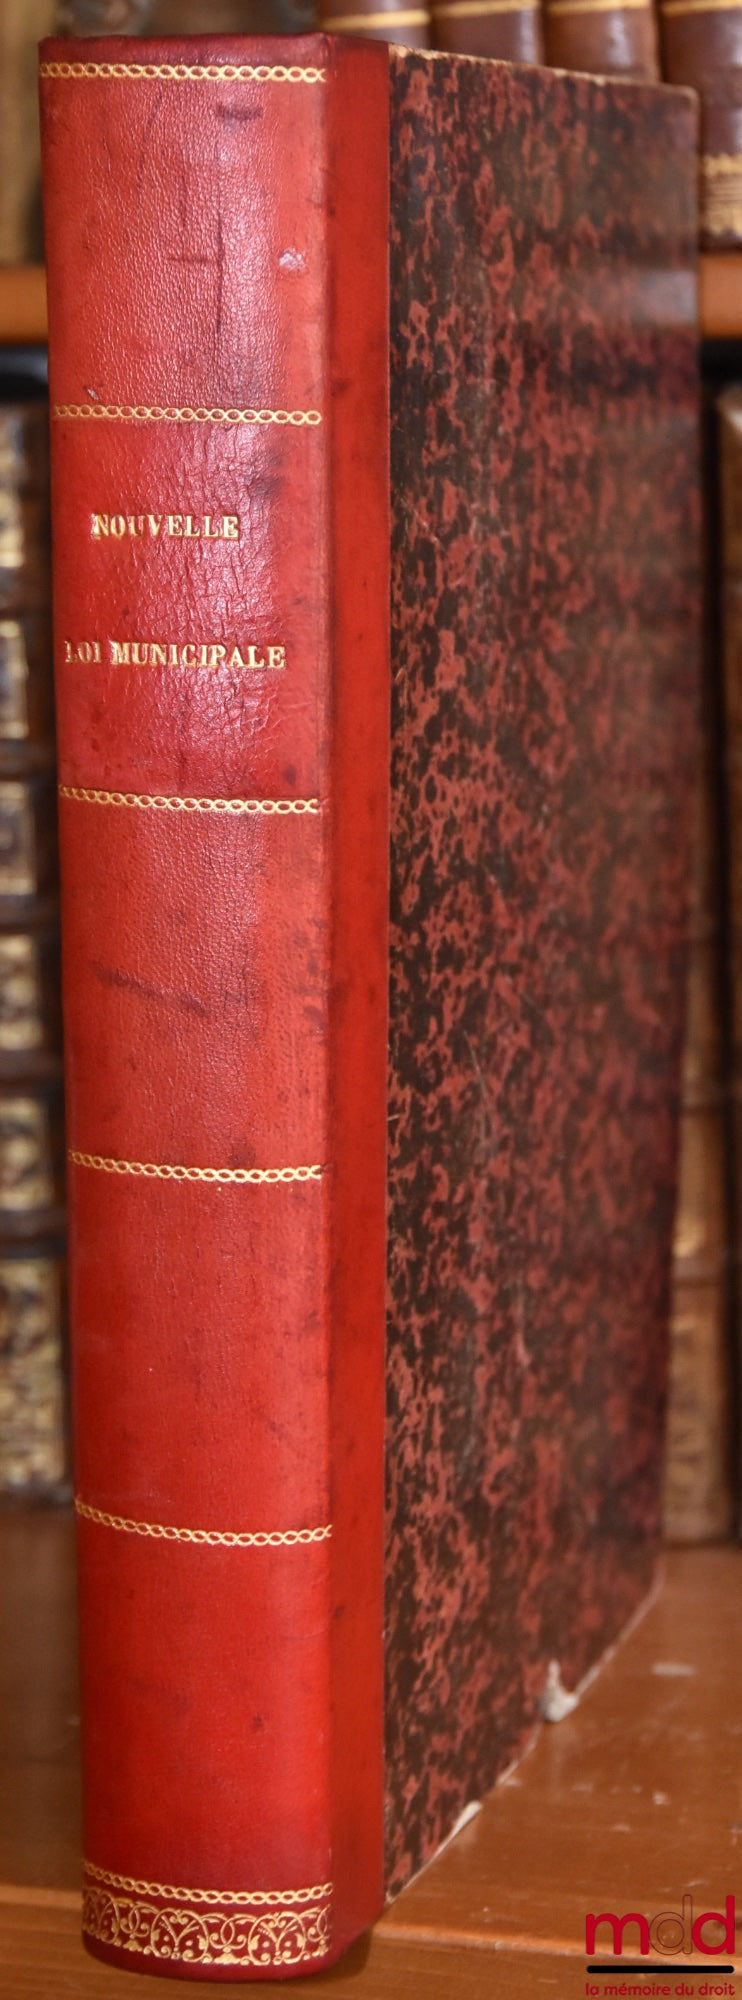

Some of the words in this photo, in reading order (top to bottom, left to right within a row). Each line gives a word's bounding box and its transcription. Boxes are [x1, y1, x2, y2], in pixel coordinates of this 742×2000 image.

[91, 513, 240, 539] NOUVELLE
[64, 640, 102, 663] LOI
[109, 640, 286, 668] MUNICIPALE
